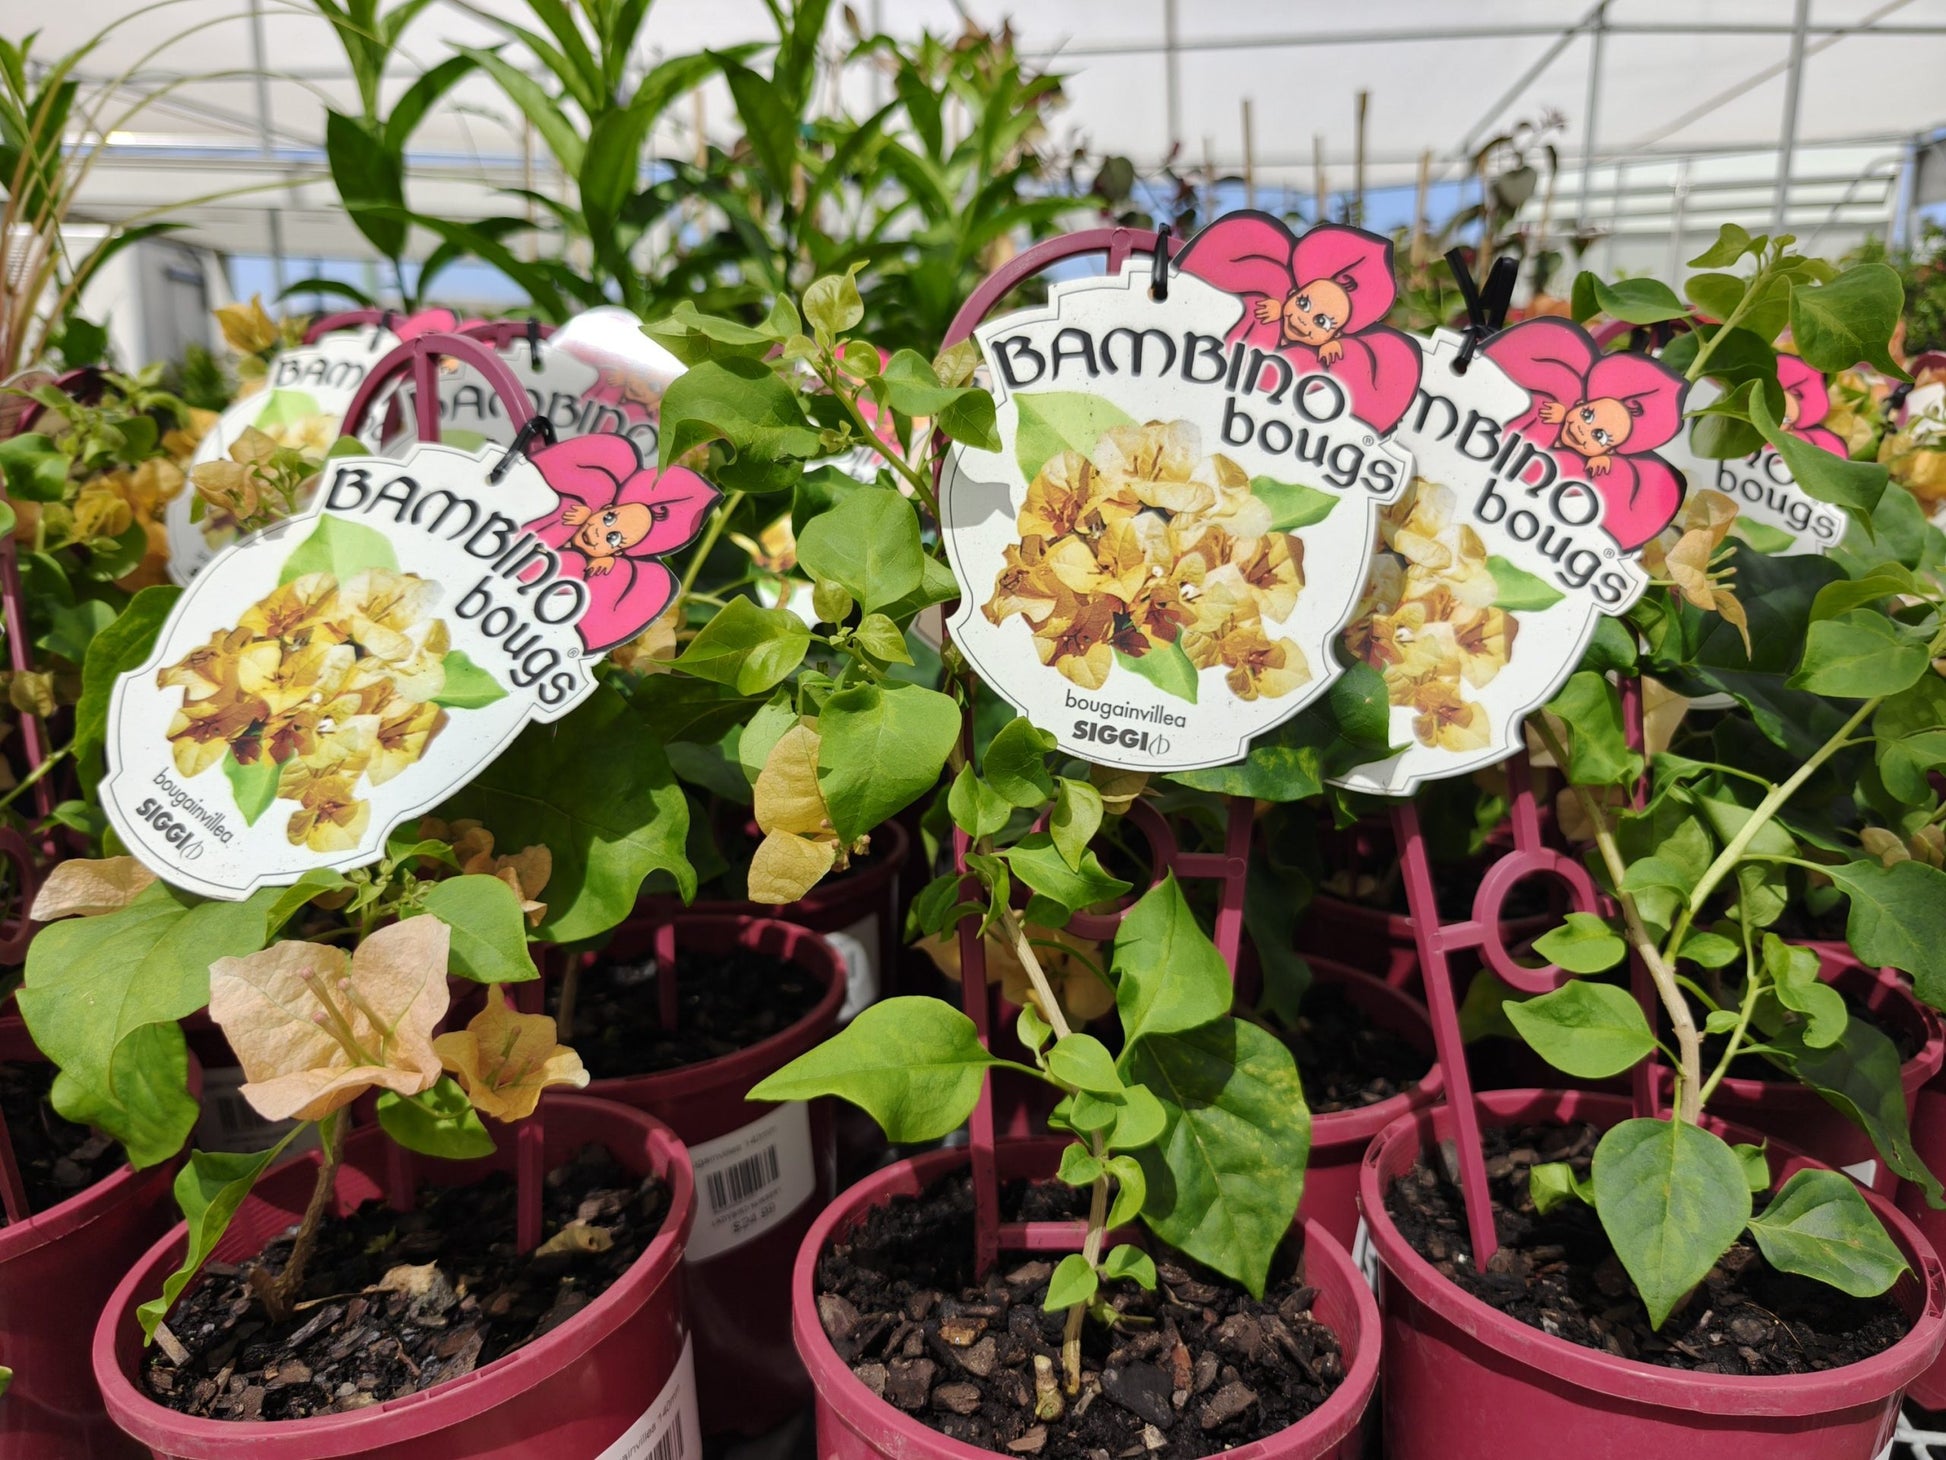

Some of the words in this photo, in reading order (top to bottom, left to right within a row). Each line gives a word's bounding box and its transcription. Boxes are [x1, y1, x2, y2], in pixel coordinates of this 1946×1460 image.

[991, 327, 1346, 424] BAMBINO
[1220, 396, 1398, 495] bougs
[1413, 387, 1600, 527] MBINO
[325, 468, 587, 625] BAMBINO
[1473, 478, 1628, 605] bougs
[1716, 459, 1836, 539] bougs
[455, 575, 577, 705] bougs
[1065, 688, 1187, 728] bougainvillea
[1071, 720, 1149, 752] SIGGI
[136, 797, 195, 851] SIGGI
[153, 766, 234, 844] bougainvillea
